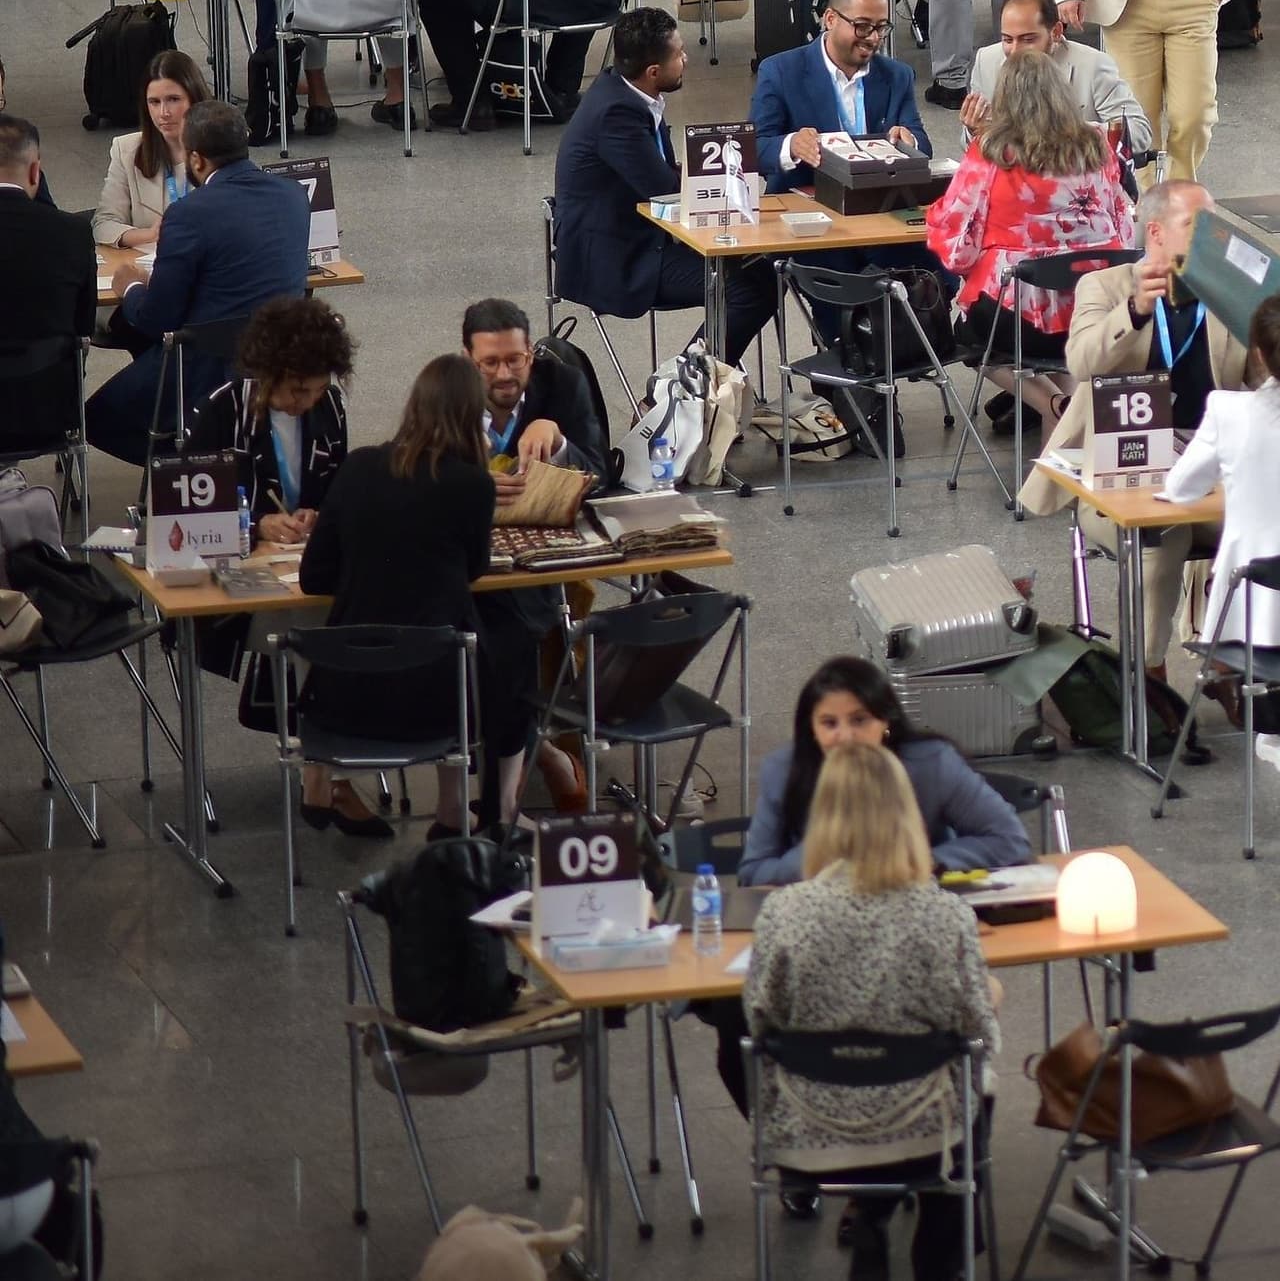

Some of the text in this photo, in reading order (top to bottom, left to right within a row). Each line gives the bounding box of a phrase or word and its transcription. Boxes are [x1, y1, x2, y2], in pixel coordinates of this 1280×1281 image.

[702, 142, 743, 171] 26
[298, 178, 318, 203] 7
[1112, 391, 1152, 426] 18
[1121, 451, 1145, 461] KATH
[173, 473, 216, 507] 19
[187, 529, 223, 550] lyria
[558, 835, 618, 878] 09
